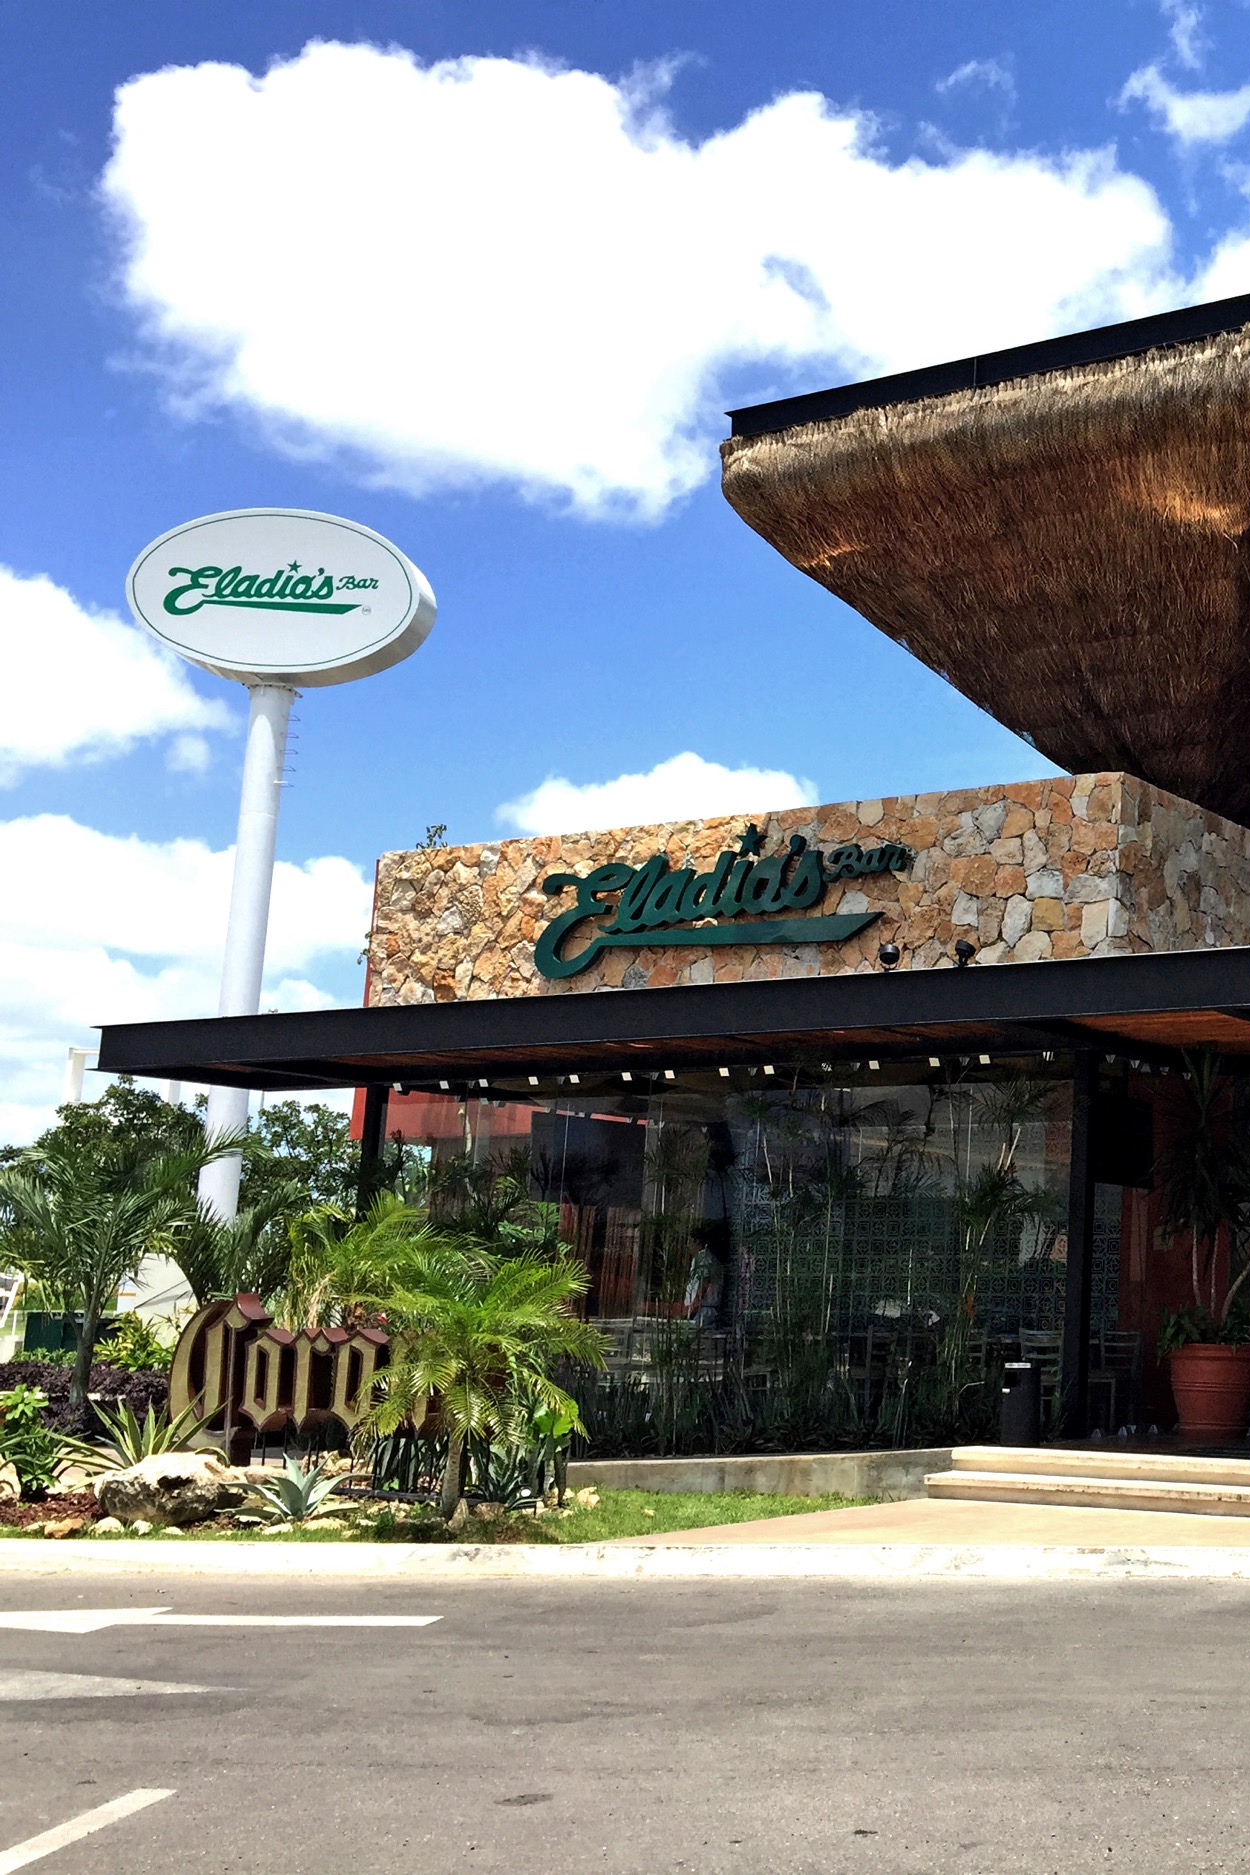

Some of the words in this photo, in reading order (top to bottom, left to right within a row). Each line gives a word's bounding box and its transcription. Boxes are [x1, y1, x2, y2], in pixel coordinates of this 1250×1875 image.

[163, 559, 335, 615] Eladio's
[336, 575, 379, 591] Bar
[533, 823, 828, 979] Eladio's
[823, 843, 911, 882] Bar
